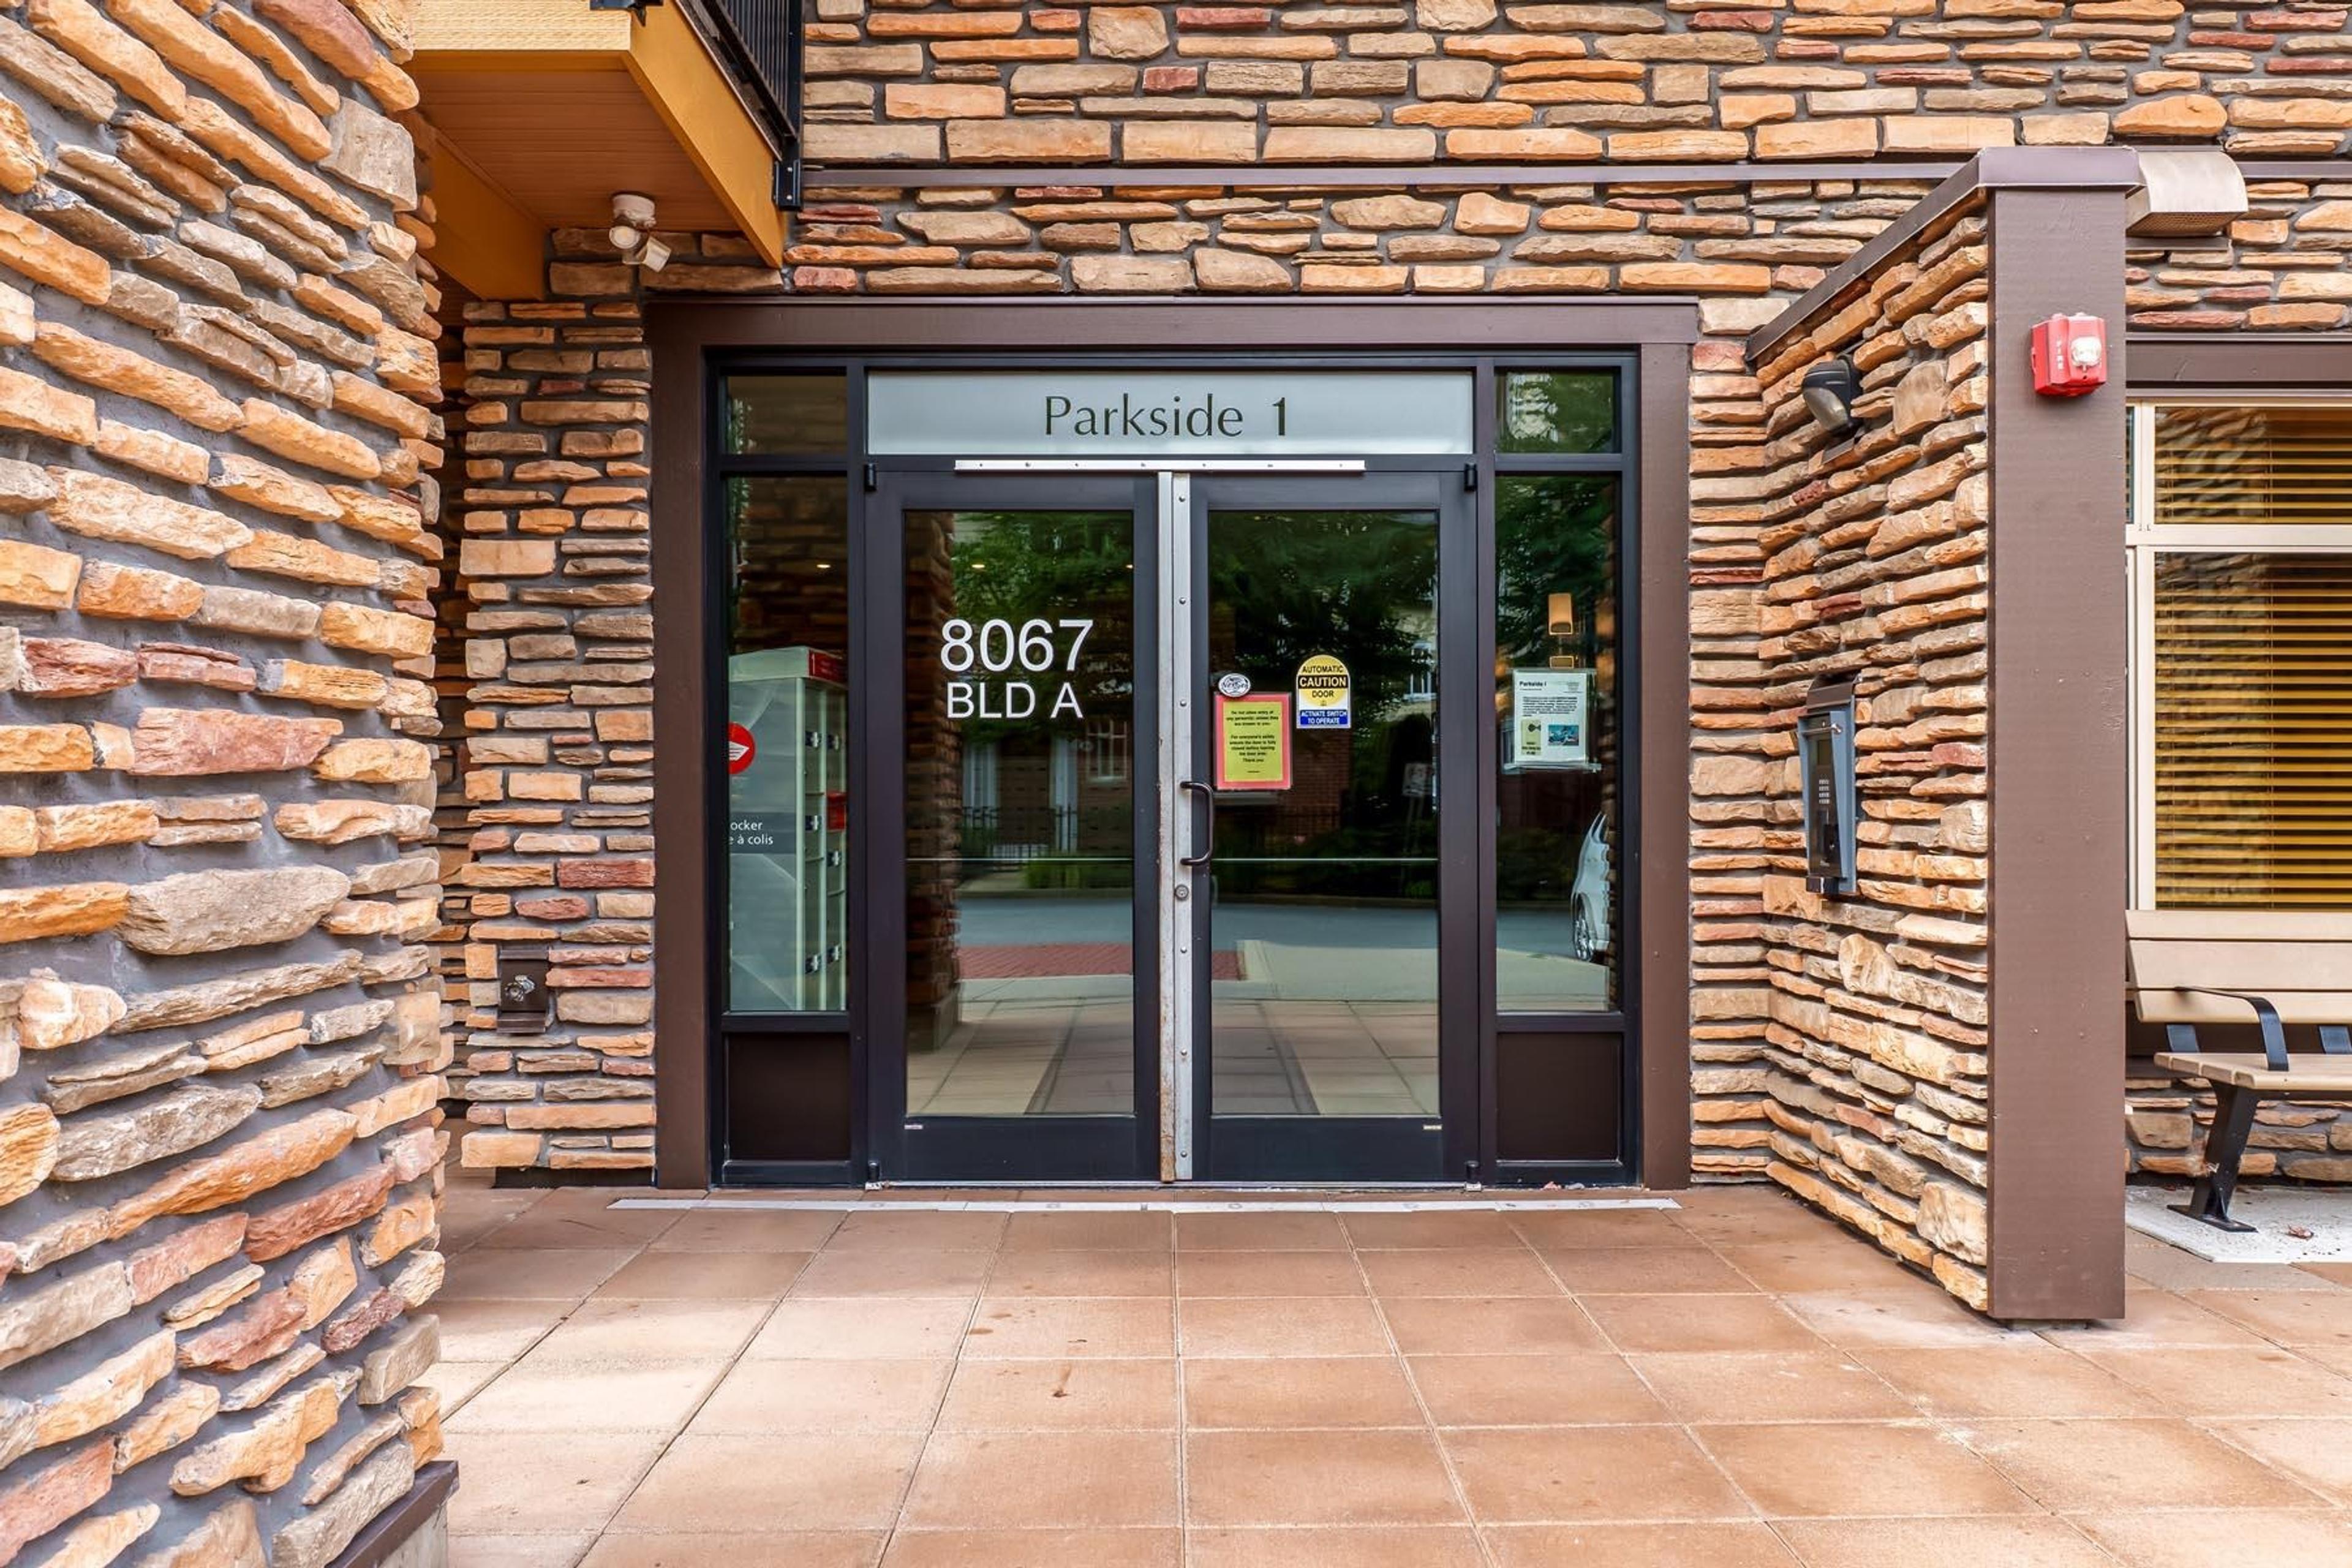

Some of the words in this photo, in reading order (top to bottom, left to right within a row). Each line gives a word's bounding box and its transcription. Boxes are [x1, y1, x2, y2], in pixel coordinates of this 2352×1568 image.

[1045, 393, 1243, 436] Parkside
[1272, 397, 1287, 435] 1
[940, 619, 1093, 672] 8067
[948, 682, 1035, 718] BLD
[1050, 682, 1083, 718] A
[1300, 677, 1346, 687] CAUTION
[748, 833, 774, 845] colis
